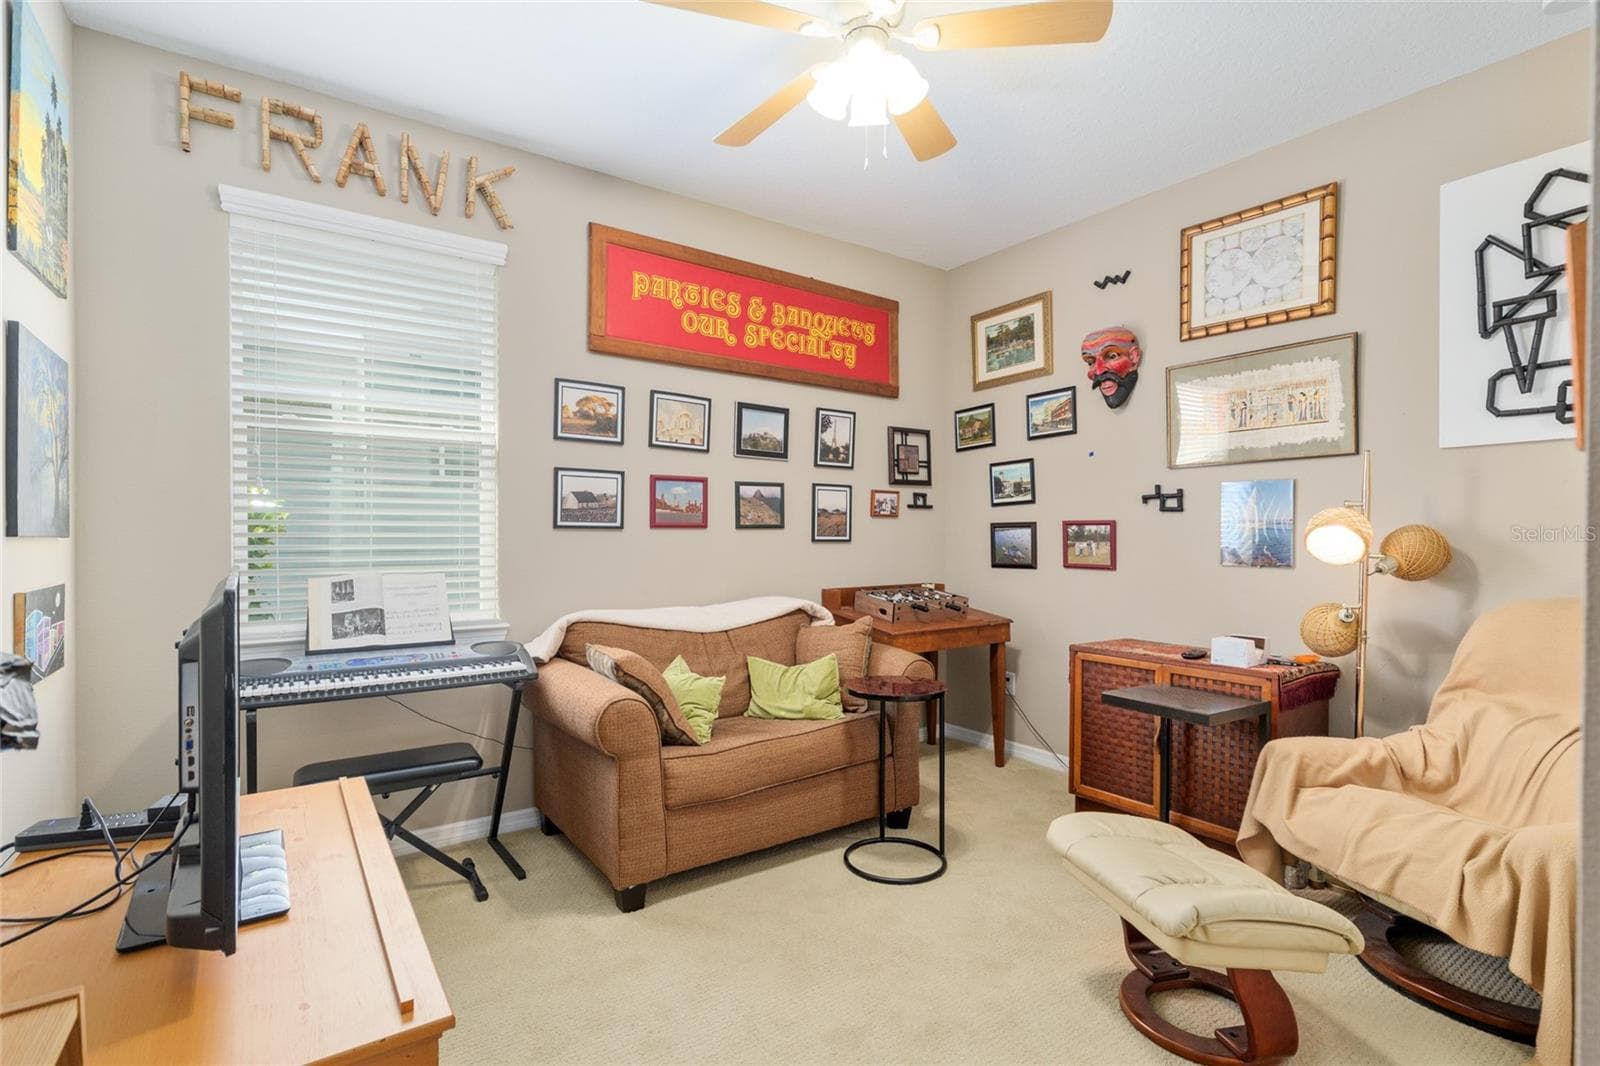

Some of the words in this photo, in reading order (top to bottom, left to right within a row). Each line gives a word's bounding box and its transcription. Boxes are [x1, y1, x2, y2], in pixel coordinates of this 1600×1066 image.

[179, 71, 517, 230] FRANK
[632, 271, 741, 317] PARTIES
[747, 296, 766, 322] &
[772, 302, 876, 347] BANQUETS
[681, 310, 737, 346] OUR
[743, 324, 857, 368] SPECIALTY
